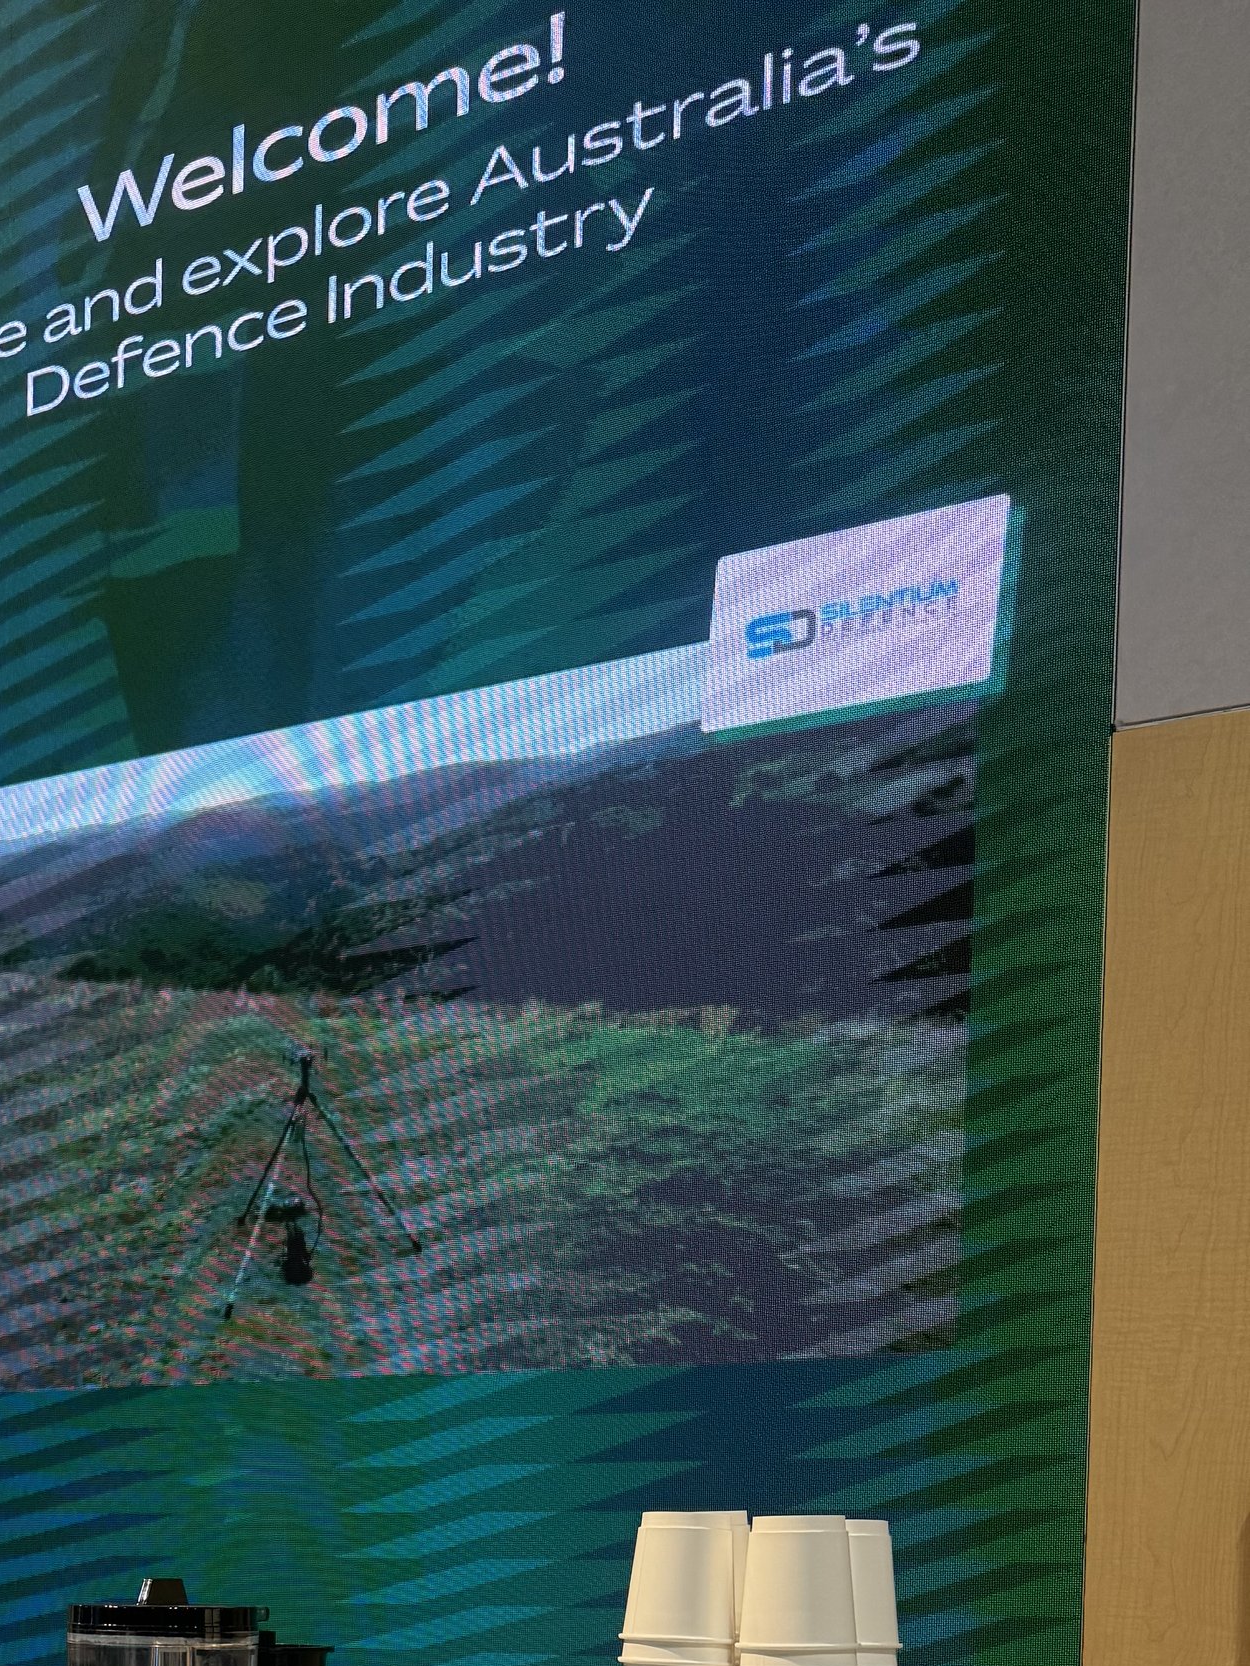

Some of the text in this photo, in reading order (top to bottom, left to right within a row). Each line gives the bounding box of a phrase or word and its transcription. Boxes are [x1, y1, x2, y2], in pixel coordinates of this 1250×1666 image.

[43, 258, 163, 343] and
[182, 180, 450, 296] explore
[470, 22, 920, 205] Australia’s
[77, 12, 565, 242] Welcome!
[25, 188, 654, 416] Defence Industry
[820, 579, 959, 621] SILENTIUM
